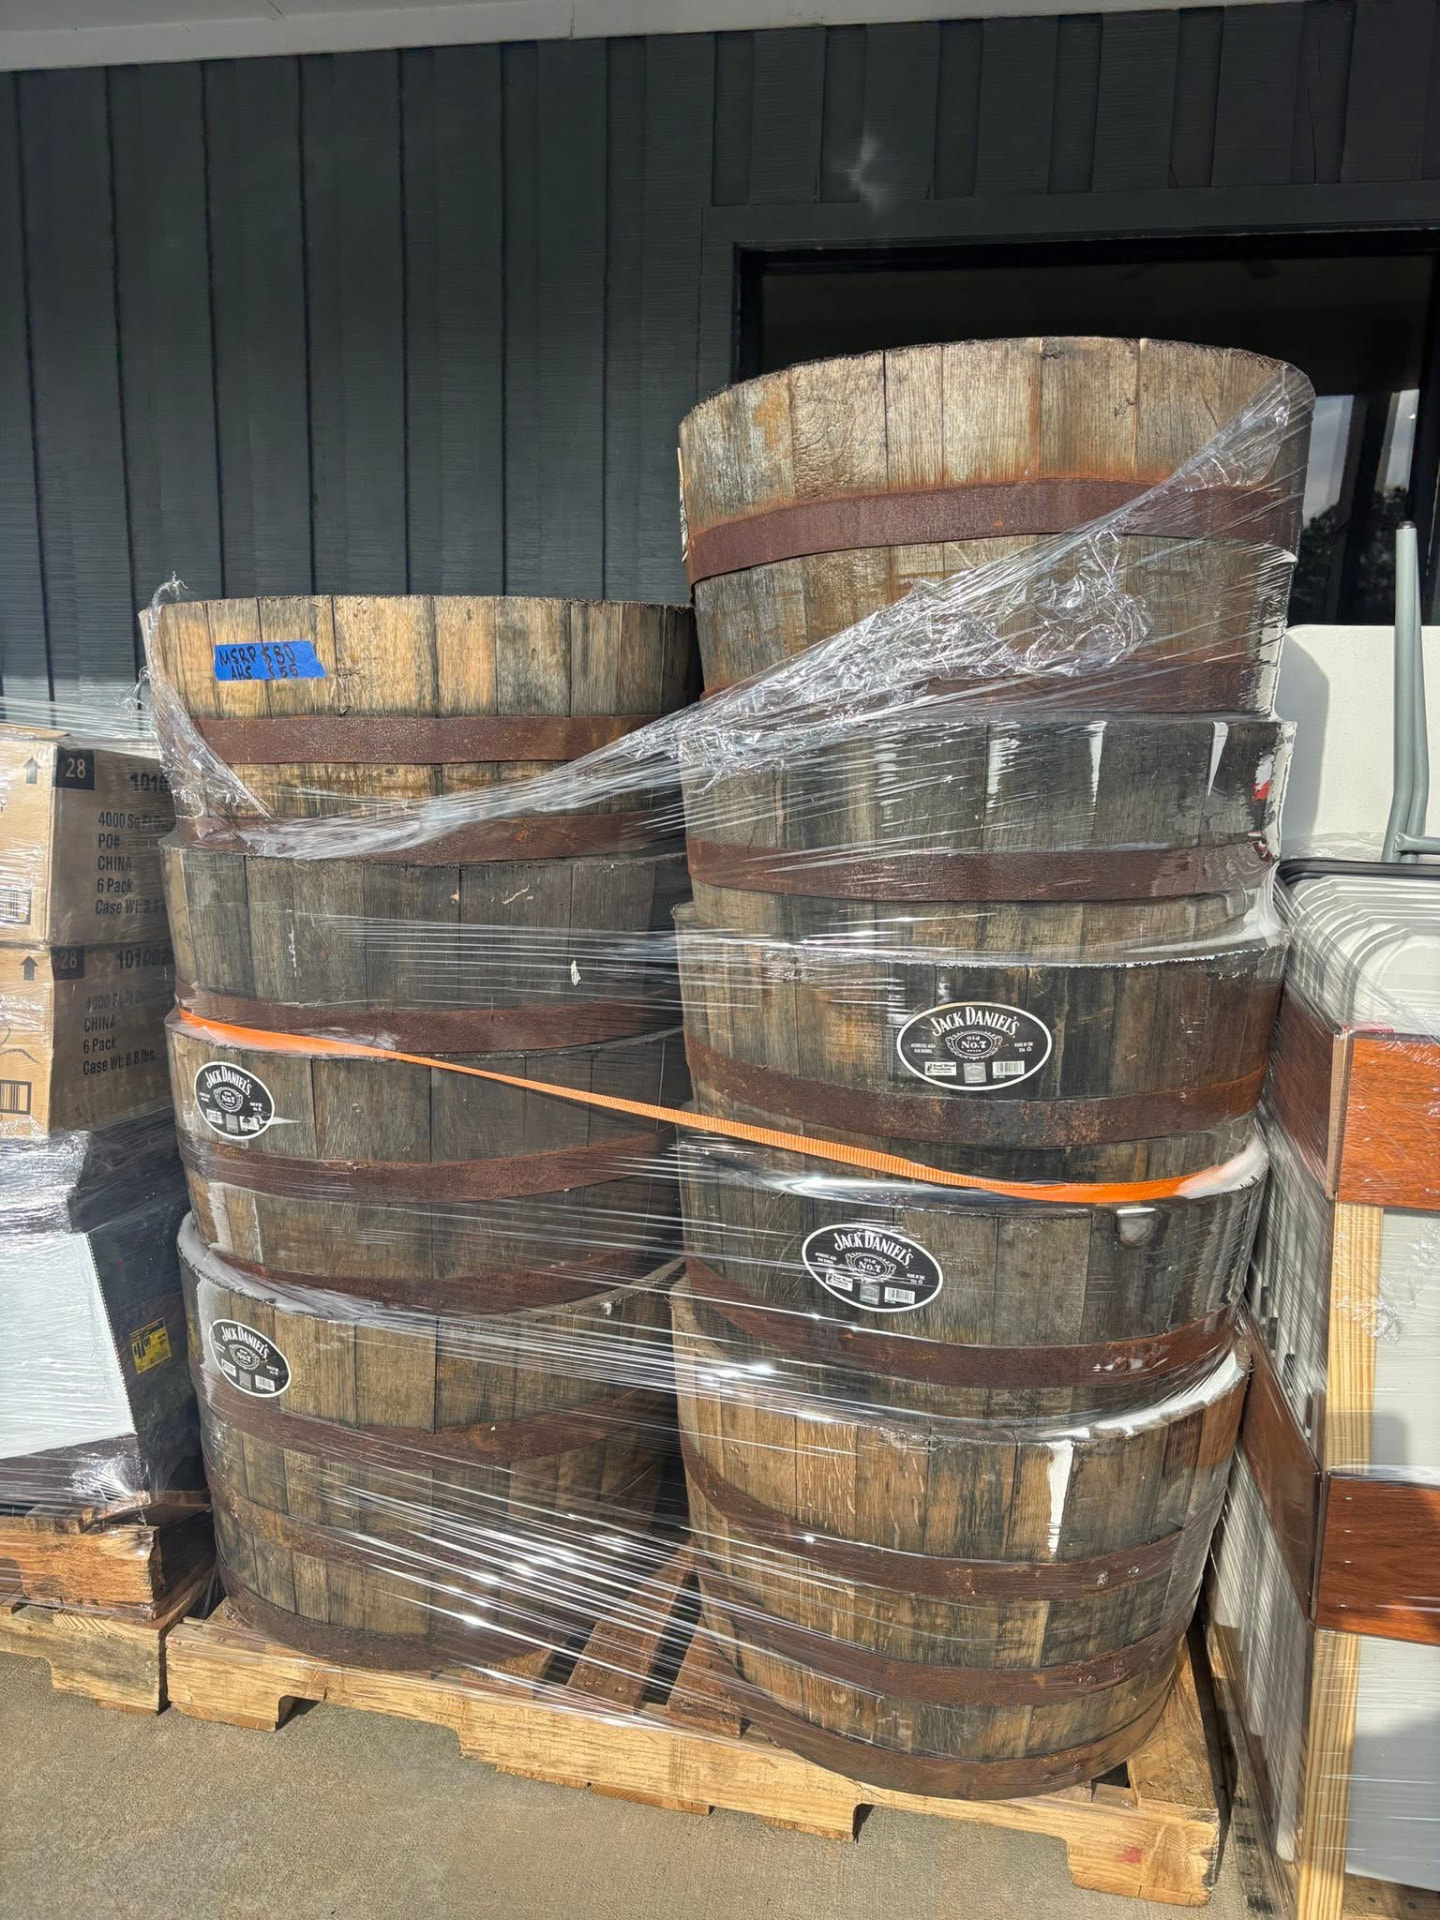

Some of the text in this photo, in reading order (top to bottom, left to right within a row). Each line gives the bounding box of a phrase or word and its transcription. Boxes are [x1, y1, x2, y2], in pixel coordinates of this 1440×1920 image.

[219, 645, 257, 666] MSRP
[65, 757, 87, 780] 28
[98, 811, 126, 828] 4000
[98, 832, 121, 849] PO#
[97, 854, 132, 871] CHINA
[96, 877, 134, 893] 6 Pack
[95, 899, 123, 915] Case
[60, 949, 79, 969] 28
[83, 1014, 116, 1033] CHINA
[930, 1006, 1020, 1037] JACK DANIEL'S
[82, 1036, 117, 1055] 6 Pack
[961, 1040, 988, 1049] No.7
[83, 1058, 108, 1076] Case
[205, 1065, 253, 1096] JACK DANIEL'S
[833, 1231, 864, 1251] JACK
[864, 1230, 914, 1266] DANIEL'S
[221, 1326, 238, 1343] JACK
[237, 1325, 270, 1360] DANIEL'S
